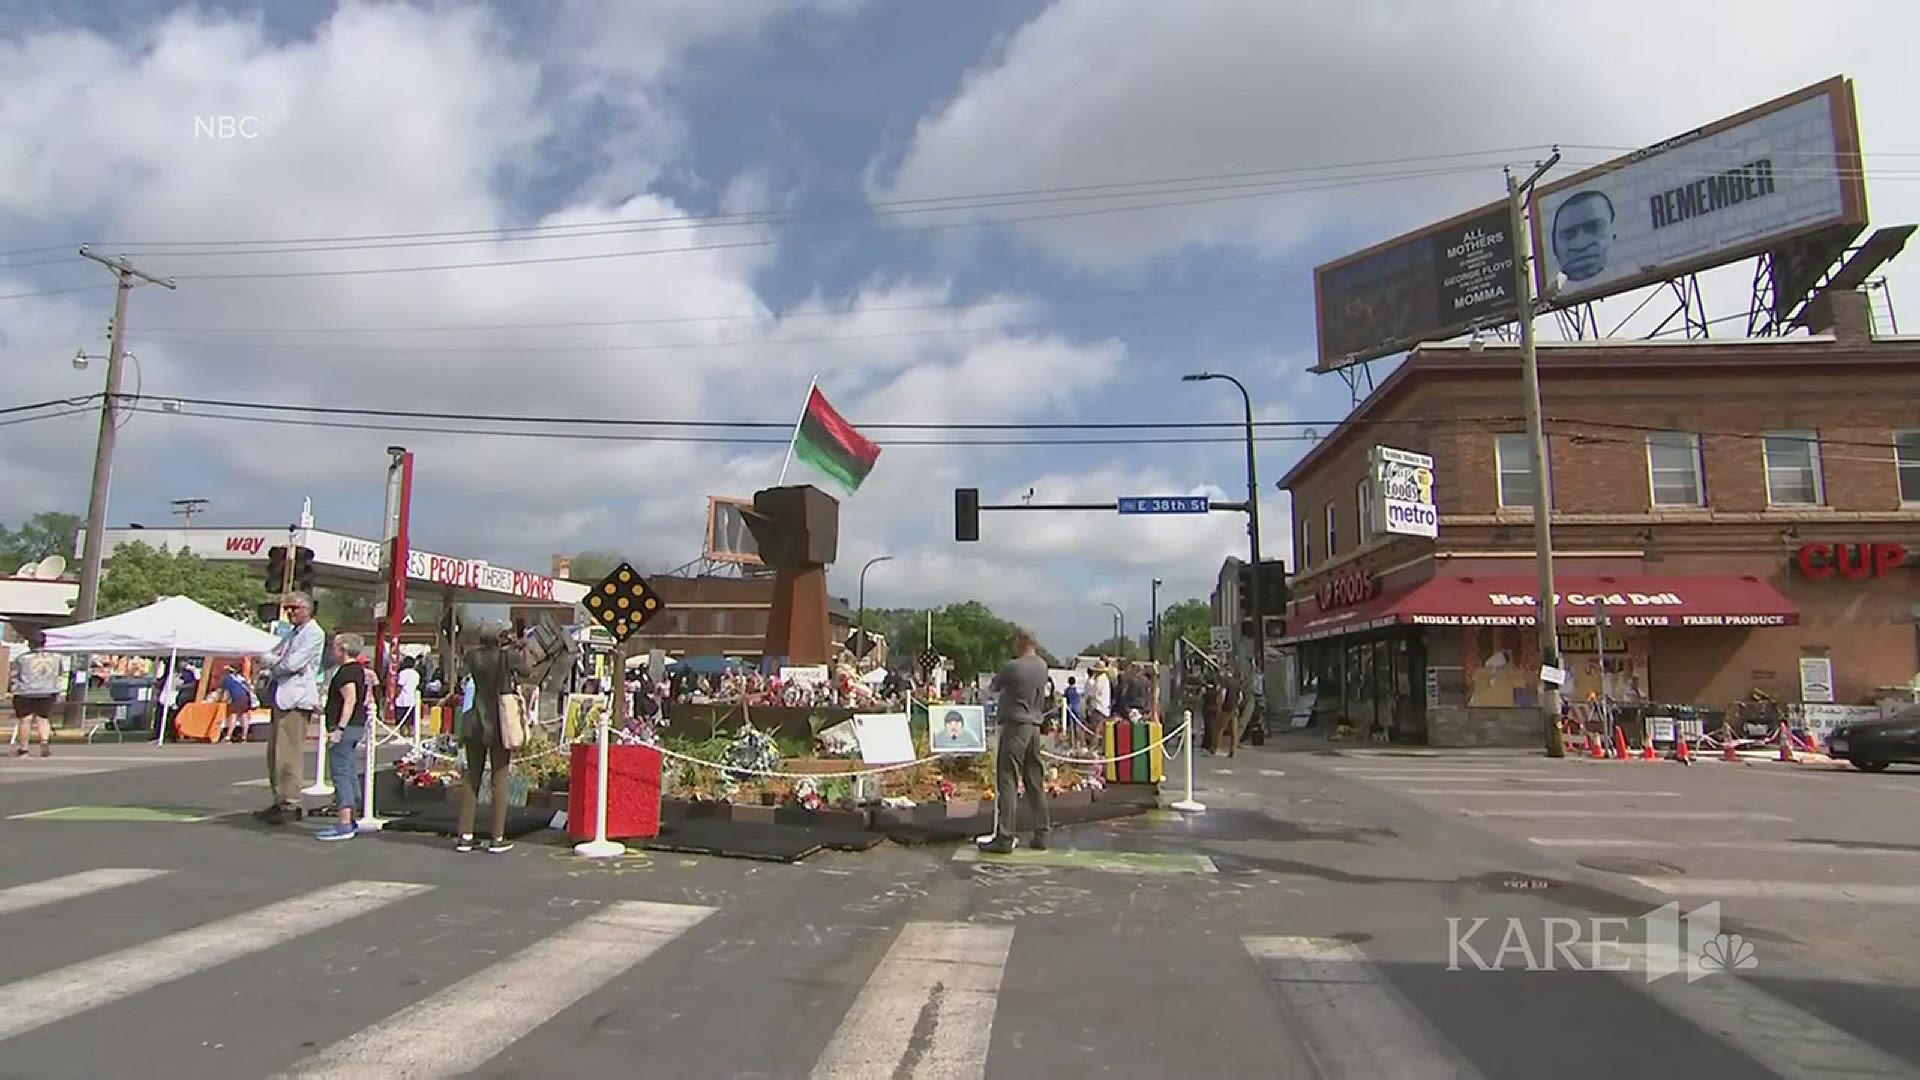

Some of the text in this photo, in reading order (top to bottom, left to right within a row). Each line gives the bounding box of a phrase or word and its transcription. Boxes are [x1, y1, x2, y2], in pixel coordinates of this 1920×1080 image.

[1650, 159, 1775, 229] REMEMBER
[1446, 232, 1504, 258] MOTHERS
[1463, 228, 1485, 244] ALL
[1482, 259, 1513, 275] FLOYD
[1454, 286, 1505, 309] MOMMA
[1386, 461, 1414, 483] Cup
[1386, 479, 1418, 500] Foods
[1137, 499, 1206, 511] E 38th St
[1389, 505, 1435, 525] metro
[226, 537, 265, 555] way
[338, 540, 380, 566] WHERE
[429, 556, 480, 589] PEOPLE
[513, 570, 555, 601] POWER
[1798, 542, 1904, 580] CUP
[1333, 570, 1370, 604] FOODS
[1490, 594, 1535, 606] Hot
[1413, 615, 1459, 625] MIDDLE
[1461, 616, 1517, 626] EASTERN
[1566, 616, 1611, 626] CHEEE
[1625, 616, 1668, 626] OLIVES
[1683, 616, 1722, 626] FRESH
[1726, 616, 1785, 626] PRODUCE
[1213, 639, 1231, 650] 25
